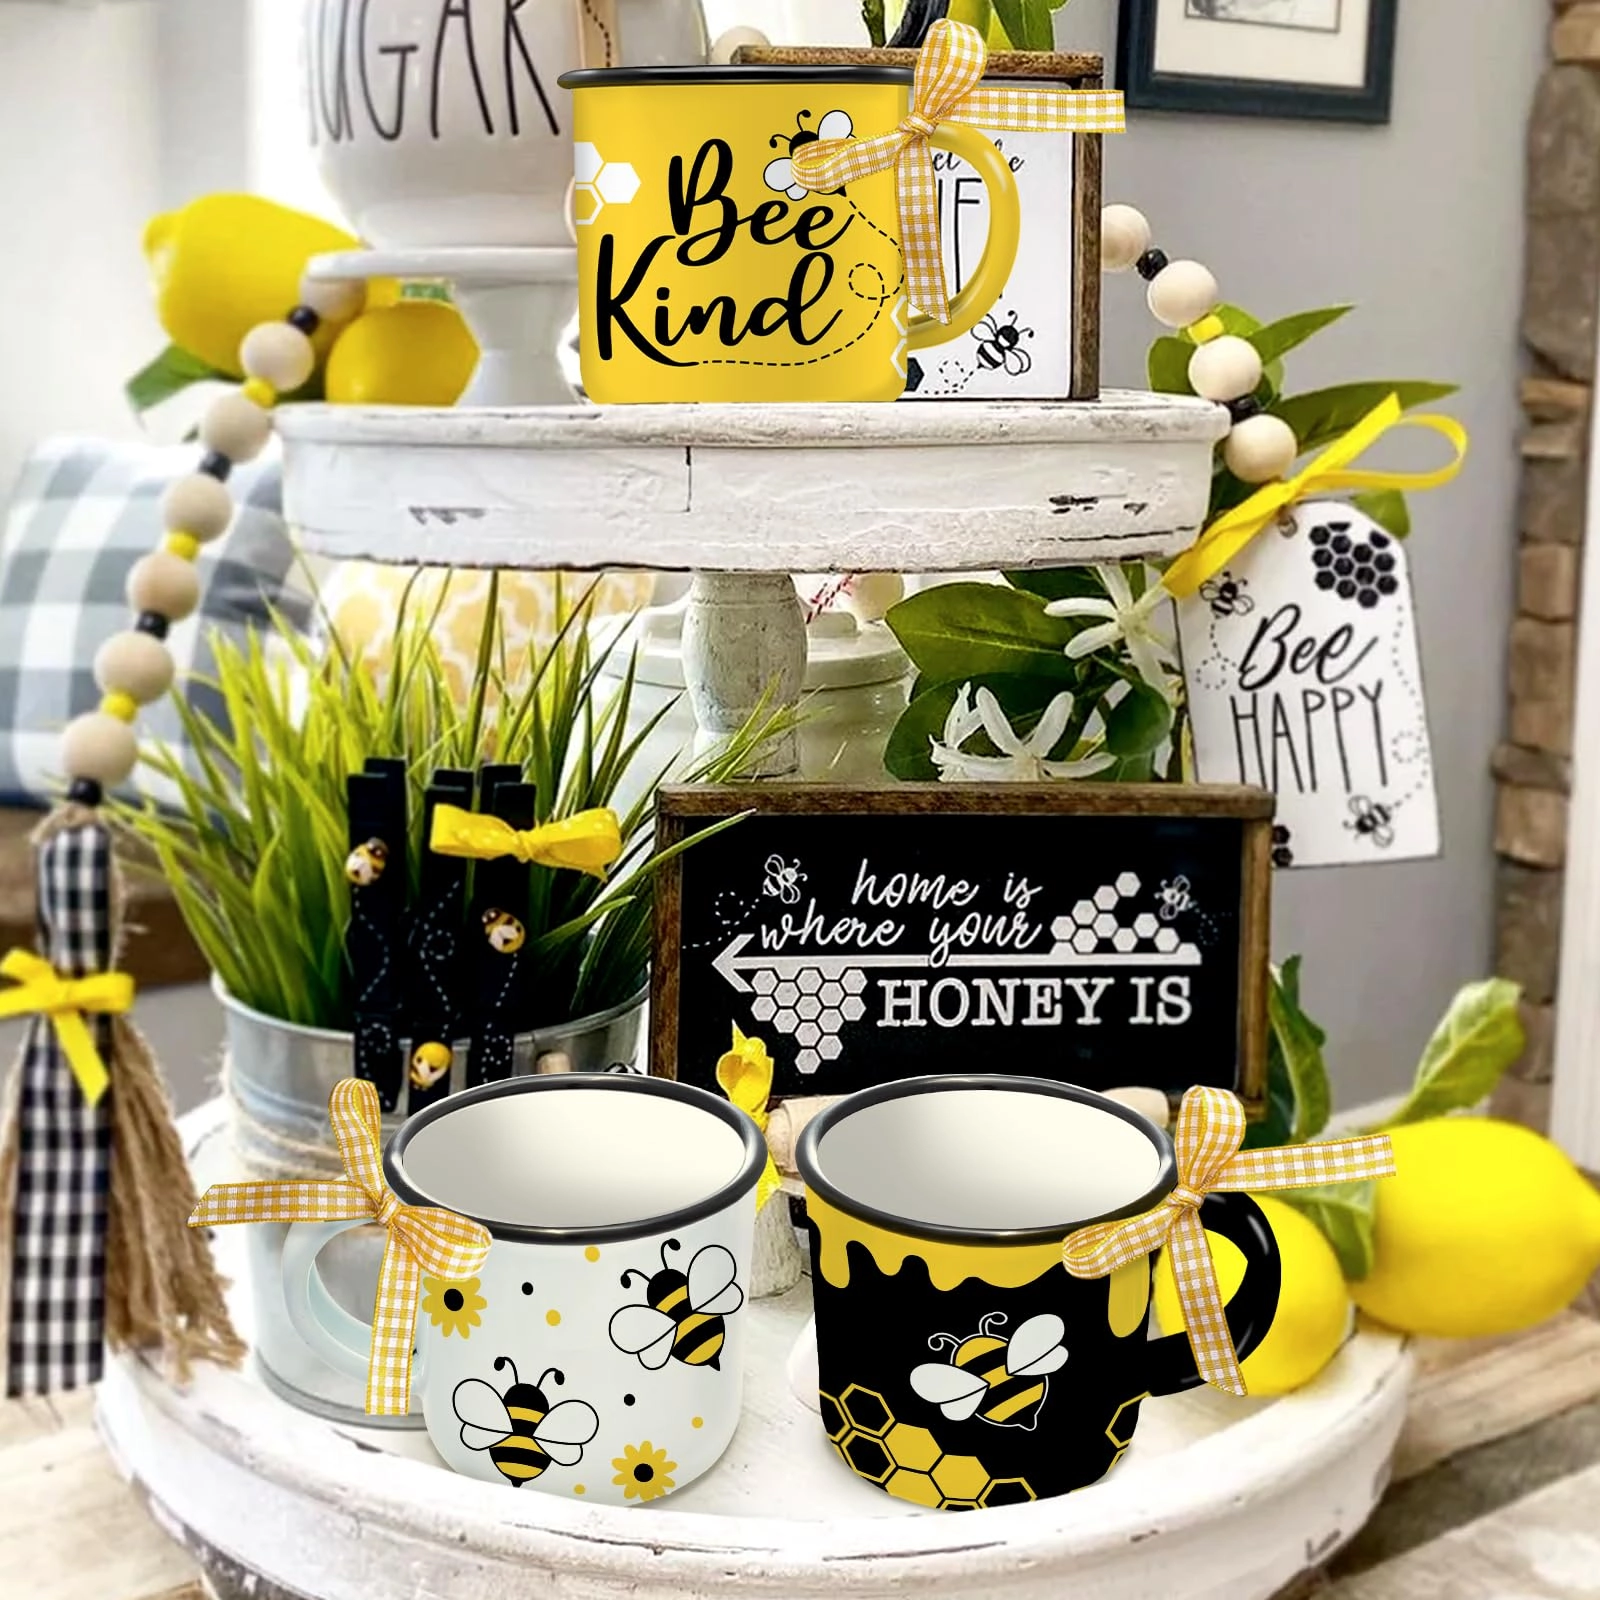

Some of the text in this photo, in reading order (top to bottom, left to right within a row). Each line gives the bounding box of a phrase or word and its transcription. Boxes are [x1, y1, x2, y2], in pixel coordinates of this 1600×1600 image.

[306, 0, 560, 146] UGAR
[668, 138, 856, 267] Bee
[595, 233, 843, 367] Kind
[1238, 603, 1379, 691] Bee
[1229, 678, 1389, 794] HAPPY
[760, 897, 1043, 968] where your
[850, 857, 1043, 909] home is
[876, 975, 1193, 1028] HONEY IS
